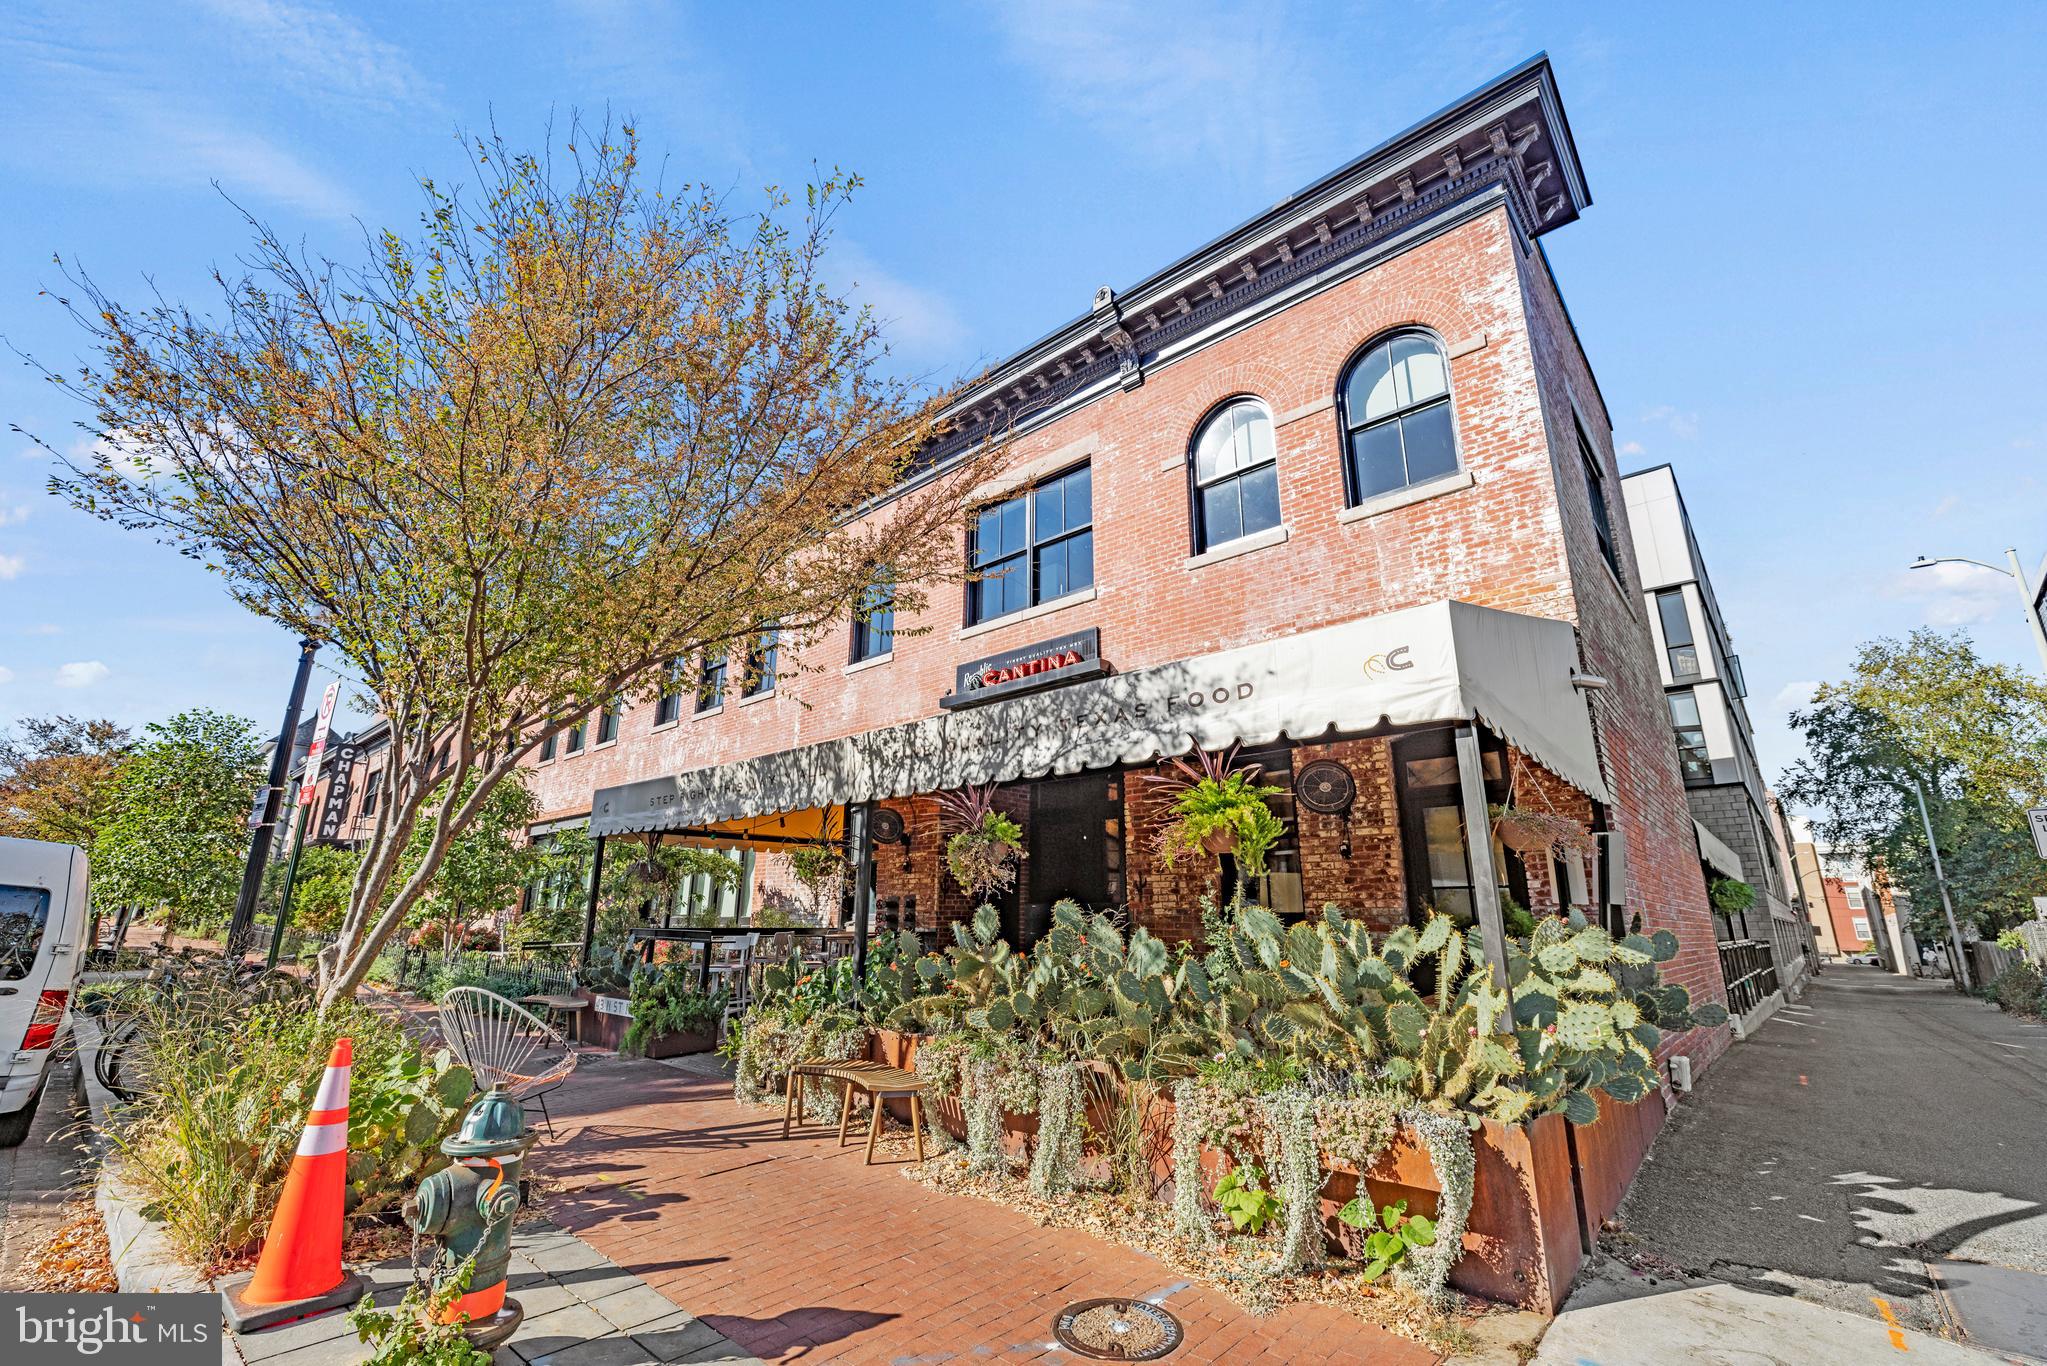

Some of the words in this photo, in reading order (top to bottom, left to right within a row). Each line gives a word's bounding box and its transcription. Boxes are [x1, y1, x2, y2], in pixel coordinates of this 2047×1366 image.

[982, 649, 1079, 687] CANTINA
[1059, 703, 1148, 732] TEXAS
[1166, 682, 1254, 713] FOOD
[322, 747, 355, 837] CHAPMAN
[649, 794, 675, 807] STEP
[680, 787, 712, 802] RIGHT
